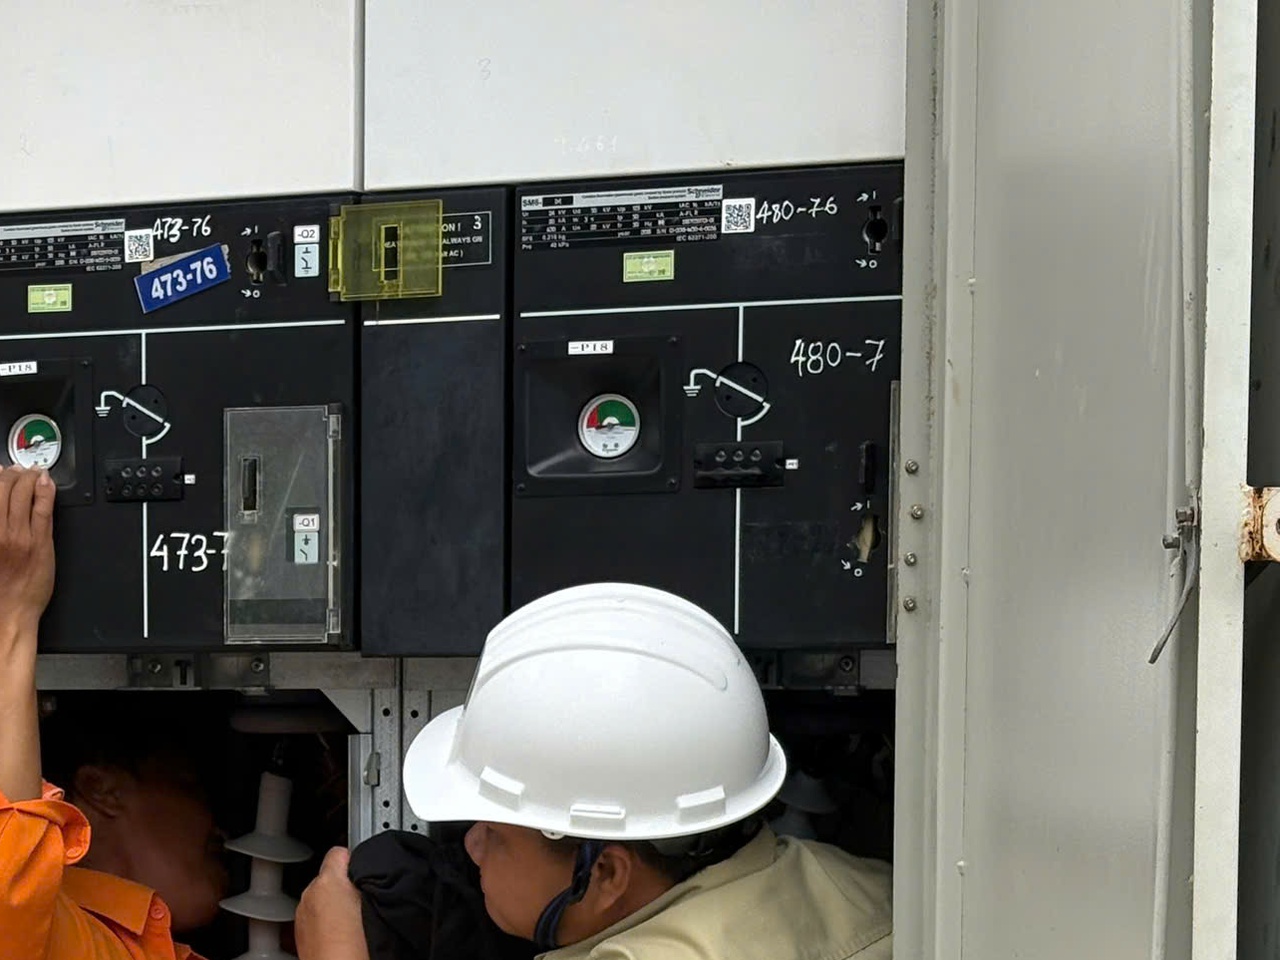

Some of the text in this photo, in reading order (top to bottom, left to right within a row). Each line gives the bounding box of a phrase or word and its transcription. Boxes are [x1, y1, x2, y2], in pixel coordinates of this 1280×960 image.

[473, 215, 482, 229] 3
[756, 196, 838, 224] 480-76
[152, 215, 212, 242] 473-76
[151, 257, 217, 300] 473-76
[790, 338, 885, 377] 480-7
[150, 531, 232, 572] 473-7
